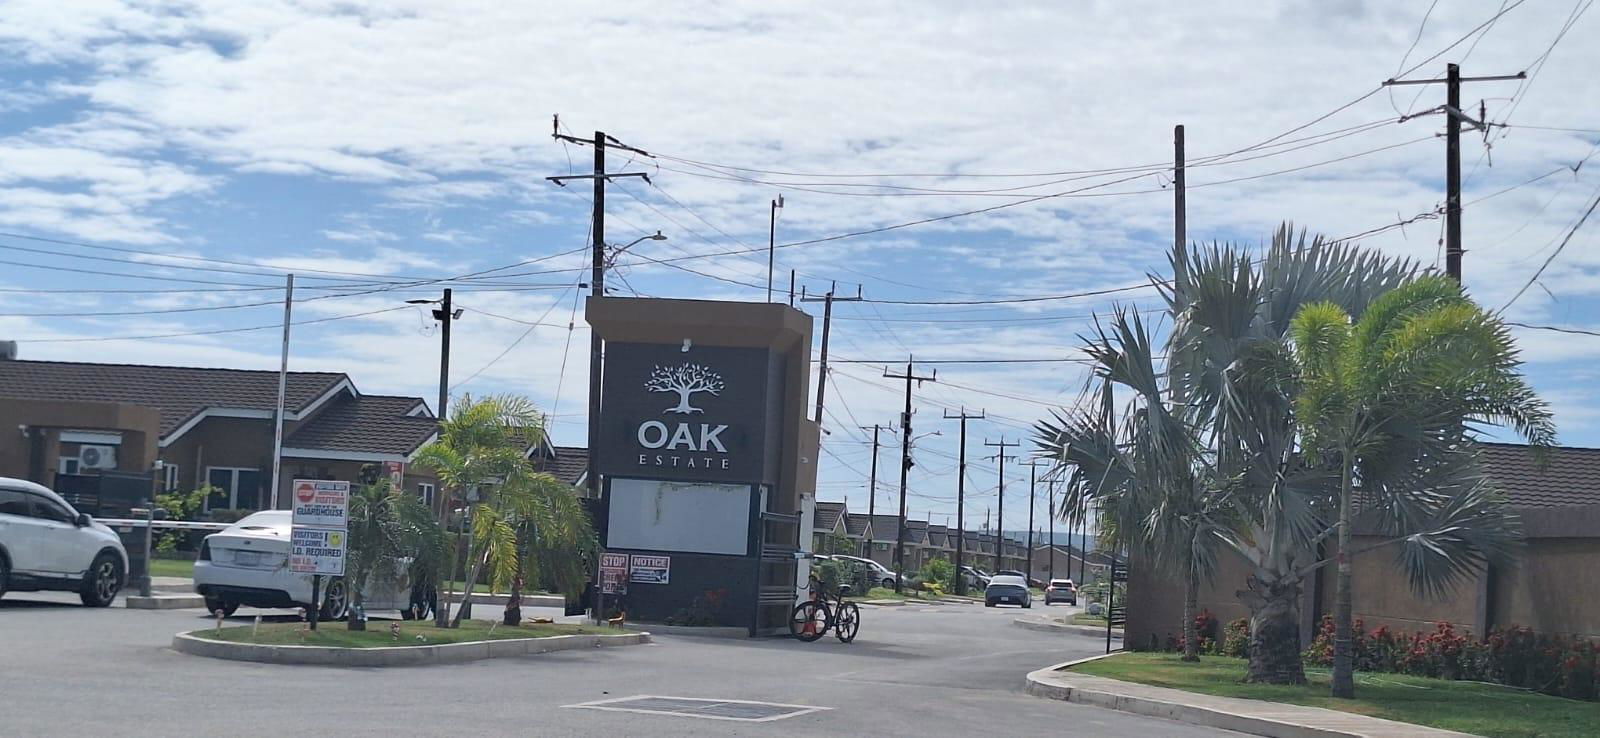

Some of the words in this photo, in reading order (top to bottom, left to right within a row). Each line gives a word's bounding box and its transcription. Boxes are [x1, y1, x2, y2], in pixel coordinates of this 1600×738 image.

[638, 421, 729, 453] OAK
[639, 454, 729, 469] ESTATE
[296, 507, 344, 517] GUARDHOUSE
[294, 531, 323, 539] VISITORS
[293, 539, 321, 547] WELCOME
[305, 547, 342, 557] REQUIRED
[602, 556, 625, 567] STOP
[633, 558, 667, 567] NOTICE
